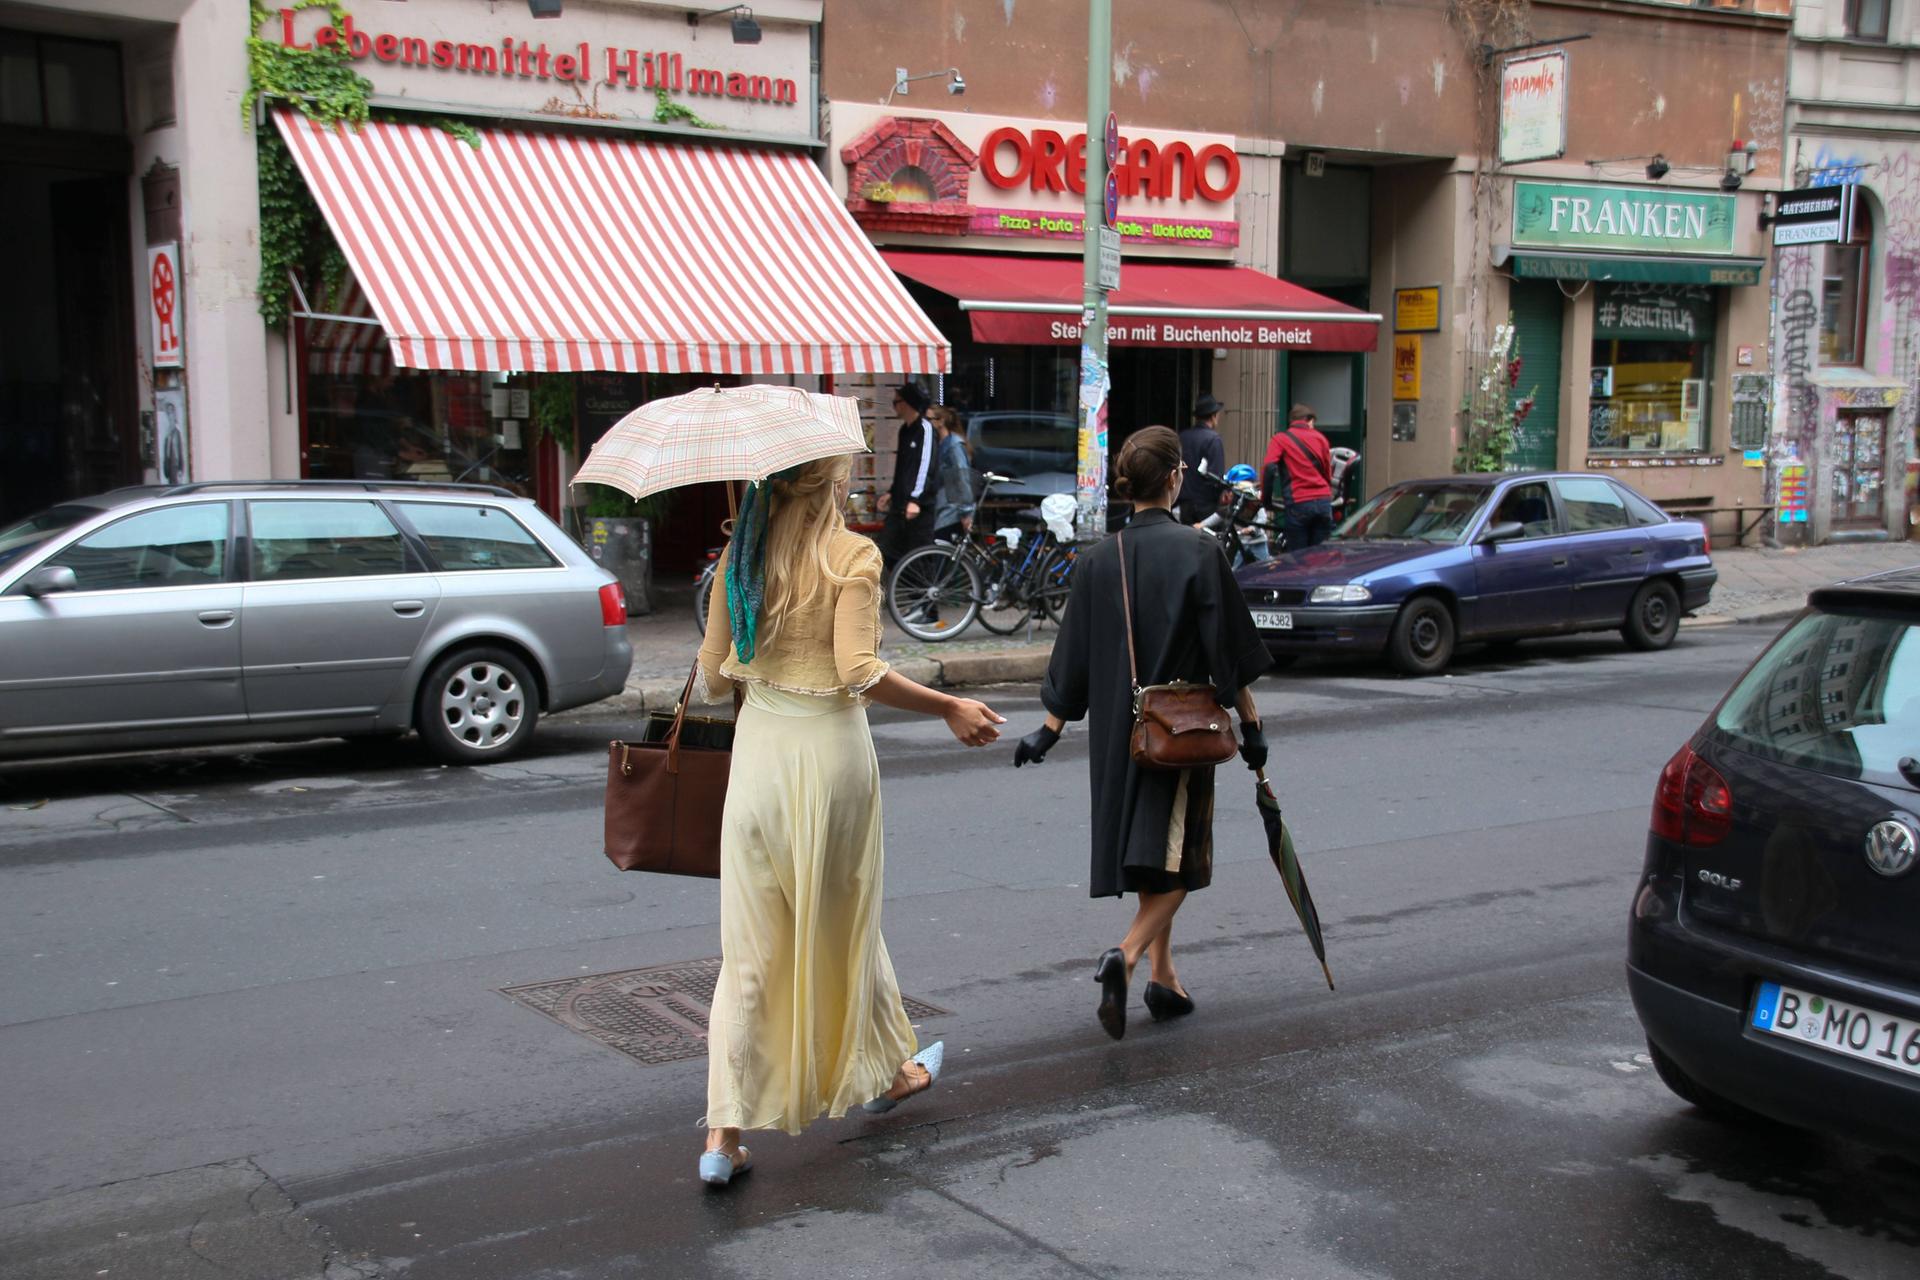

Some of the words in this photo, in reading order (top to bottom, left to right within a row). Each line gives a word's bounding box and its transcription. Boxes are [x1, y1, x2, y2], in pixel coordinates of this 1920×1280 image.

[281, 8, 591, 82] Lebensmittel
[605, 46, 798, 104] Hillmann
[1782, 199, 1834, 215] RATSHERRN
[999, 215, 1031, 230] Pizza
[1040, 217, 1073, 232] Pasta
[1548, 196, 1706, 240] FRANKEN
[1778, 223, 1837, 241] FRANKEN
[1520, 257, 1589, 278] FRANKEN
[1131, 324, 1157, 341] mit
[1163, 324, 1253, 344] Buchenholz
[1258, 327, 1312, 345] Beheizt
[1269, 614, 1290, 627] 4382
[1698, 869, 1743, 891] GOLF
[1760, 1009, 1769, 1021] D
[1775, 992, 1801, 1030] B
[1820, 1004, 1871, 1051] MO
[1875, 1020, 1920, 1067] 16
